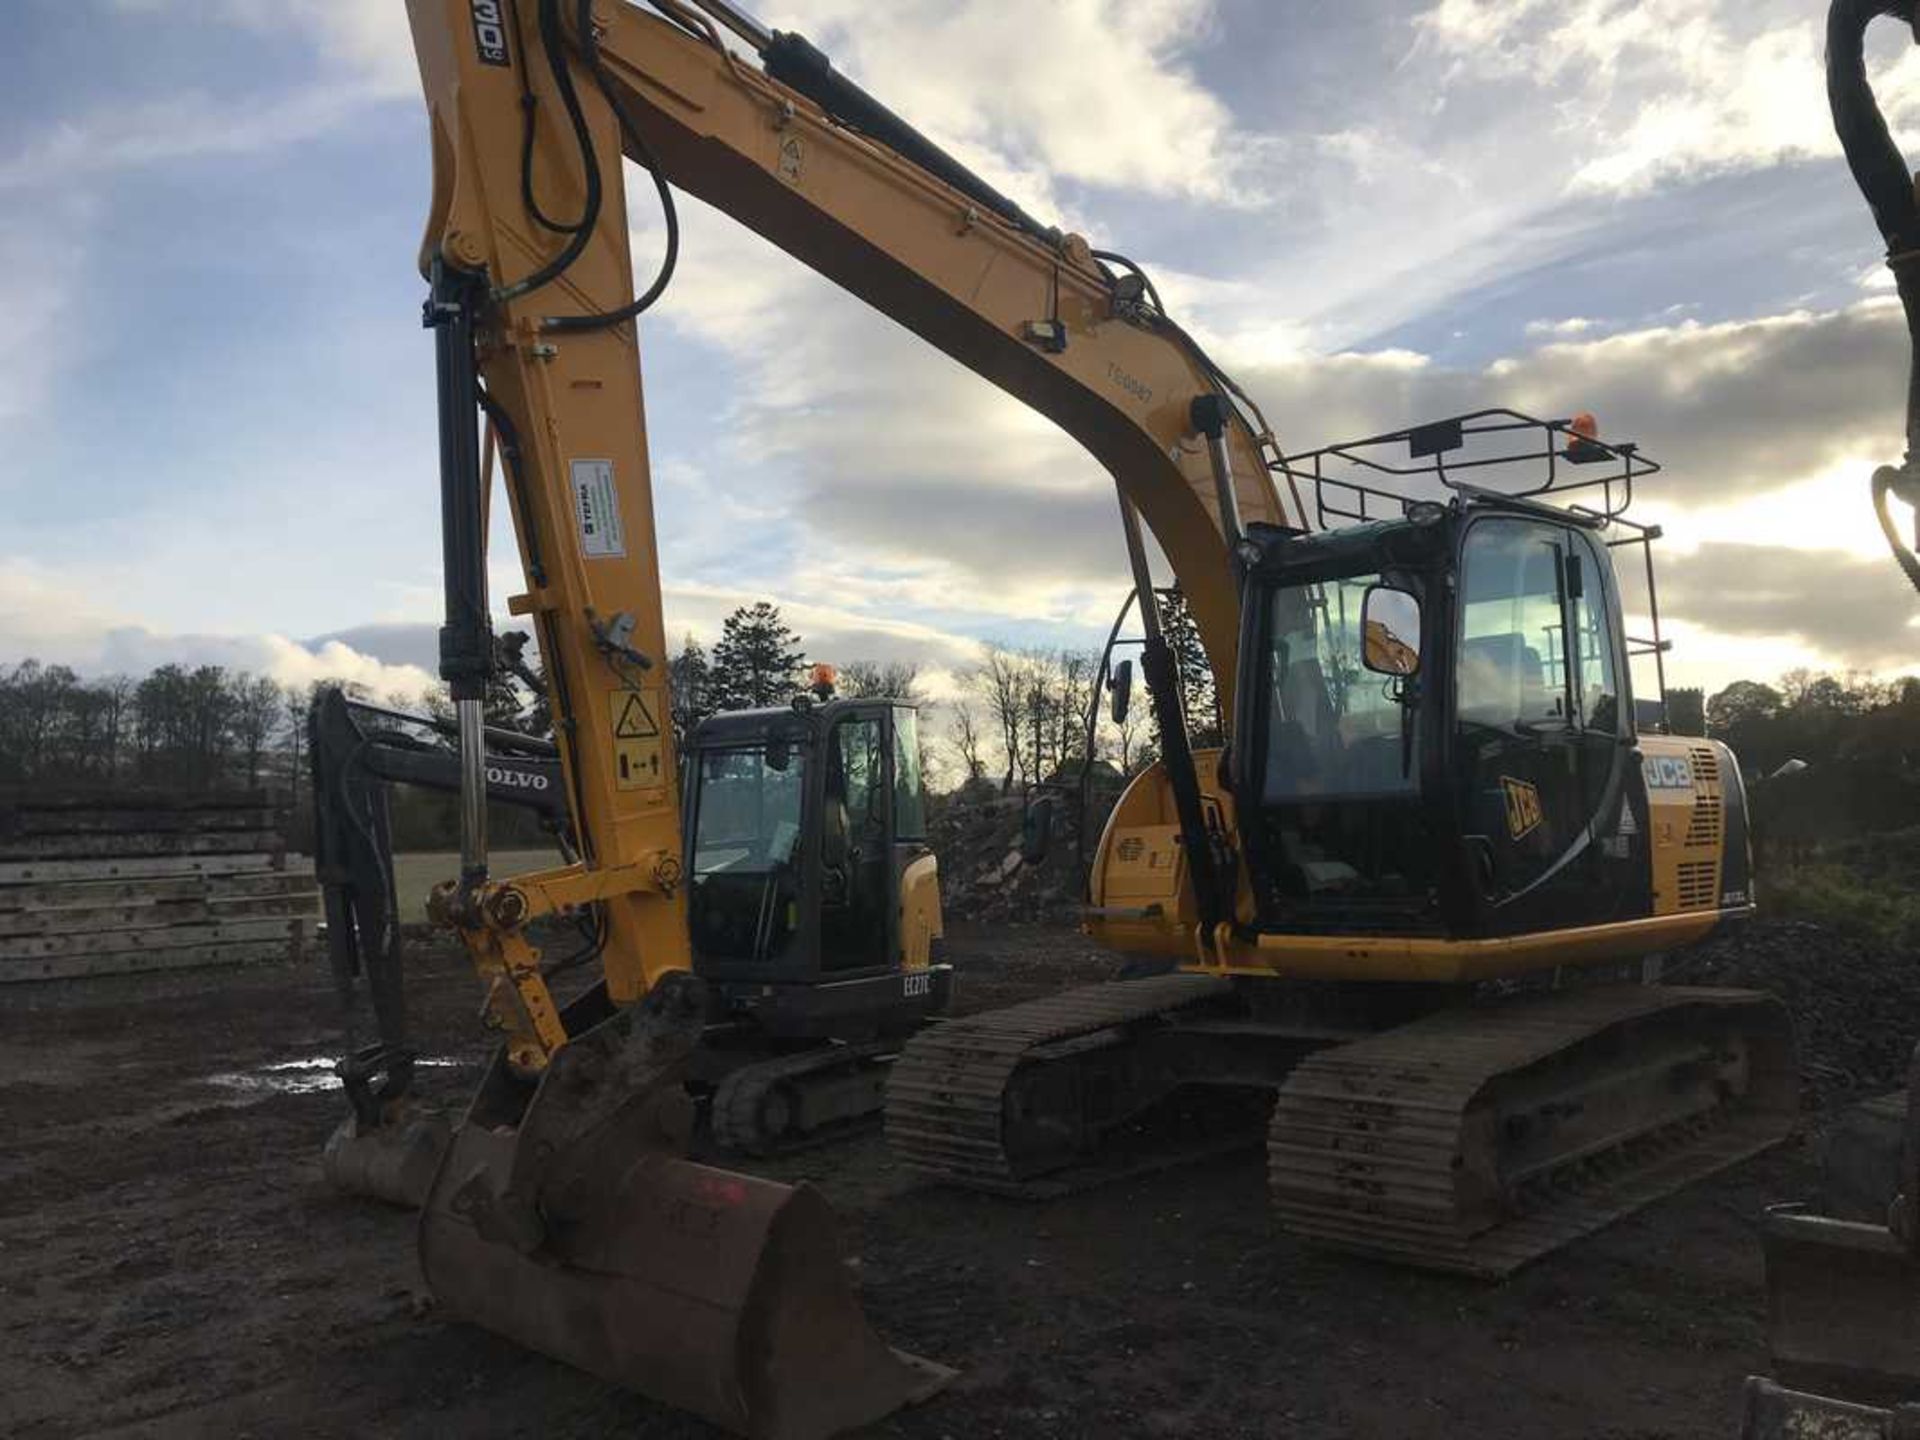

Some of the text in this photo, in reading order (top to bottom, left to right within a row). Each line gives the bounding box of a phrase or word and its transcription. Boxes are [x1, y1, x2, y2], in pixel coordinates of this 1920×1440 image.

[484, 766, 548, 790] OLVO
[1647, 758, 1691, 786] JCB
[1508, 783, 1541, 833] JCB
